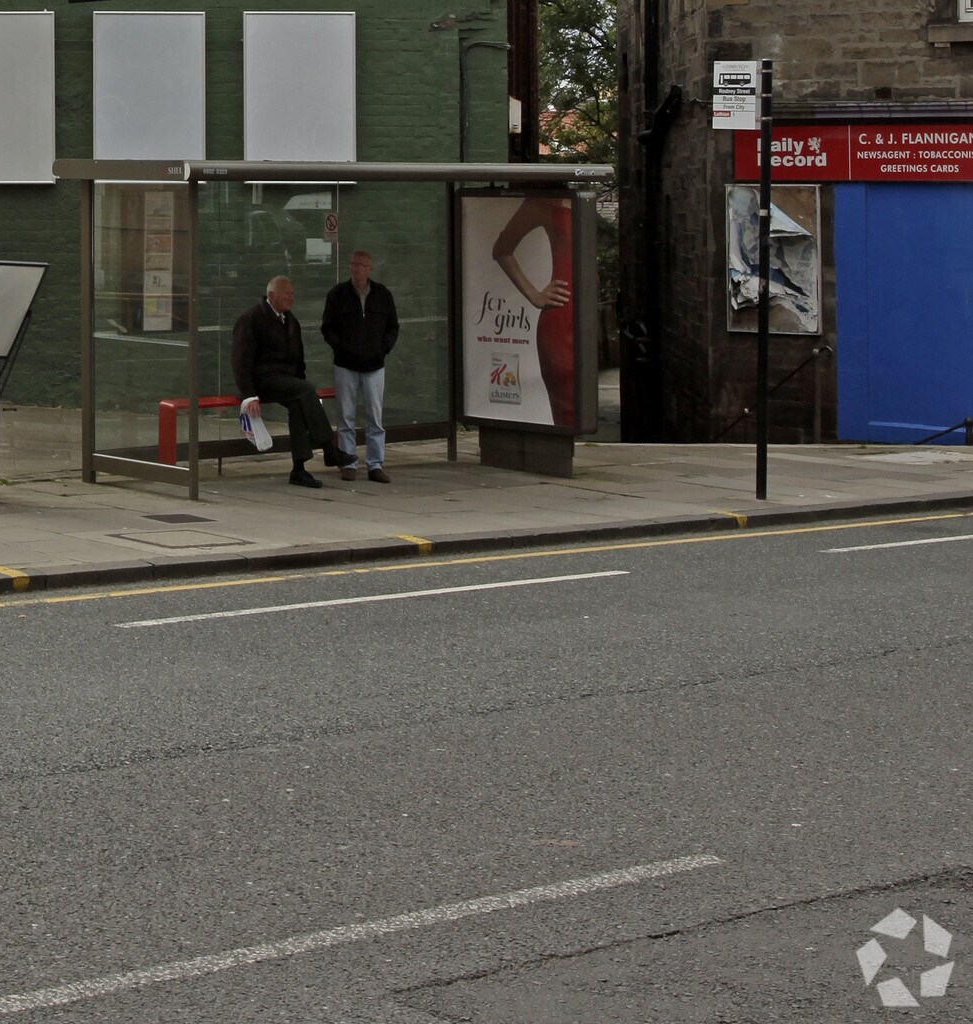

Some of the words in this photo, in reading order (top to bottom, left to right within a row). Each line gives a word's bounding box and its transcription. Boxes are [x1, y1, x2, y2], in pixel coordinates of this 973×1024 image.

[858, 133, 871, 145] C.
[875, 133, 884, 145] &
[887, 133, 897, 145] J.
[857, 151, 910, 159] NEWSAGENT
[880, 164, 928, 173] GREETINGS
[930, 164, 960, 173] CARDS
[476, 290, 506, 326] for
[493, 306, 531, 336] girls
[490, 363, 508, 386] K
[490, 390, 520, 400] clusters
